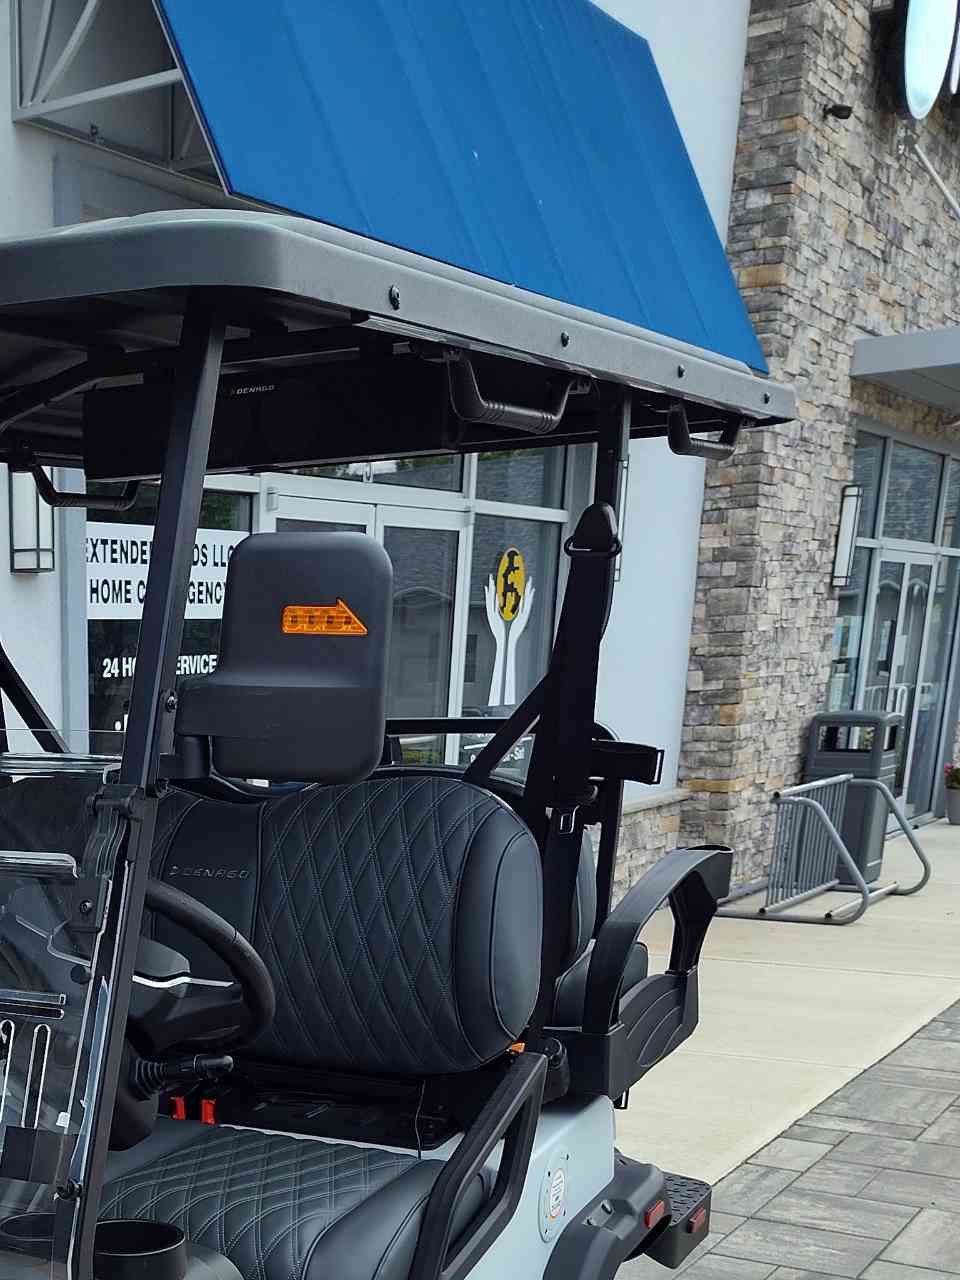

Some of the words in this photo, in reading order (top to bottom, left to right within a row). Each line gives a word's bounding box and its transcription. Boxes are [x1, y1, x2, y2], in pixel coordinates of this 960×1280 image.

[85, 537, 153, 565] XTENDE
[89, 578, 132, 604] HOME
[187, 580, 226, 605] GENC
[102, 657, 119, 678] 24
[175, 654, 218, 675] ERVICE
